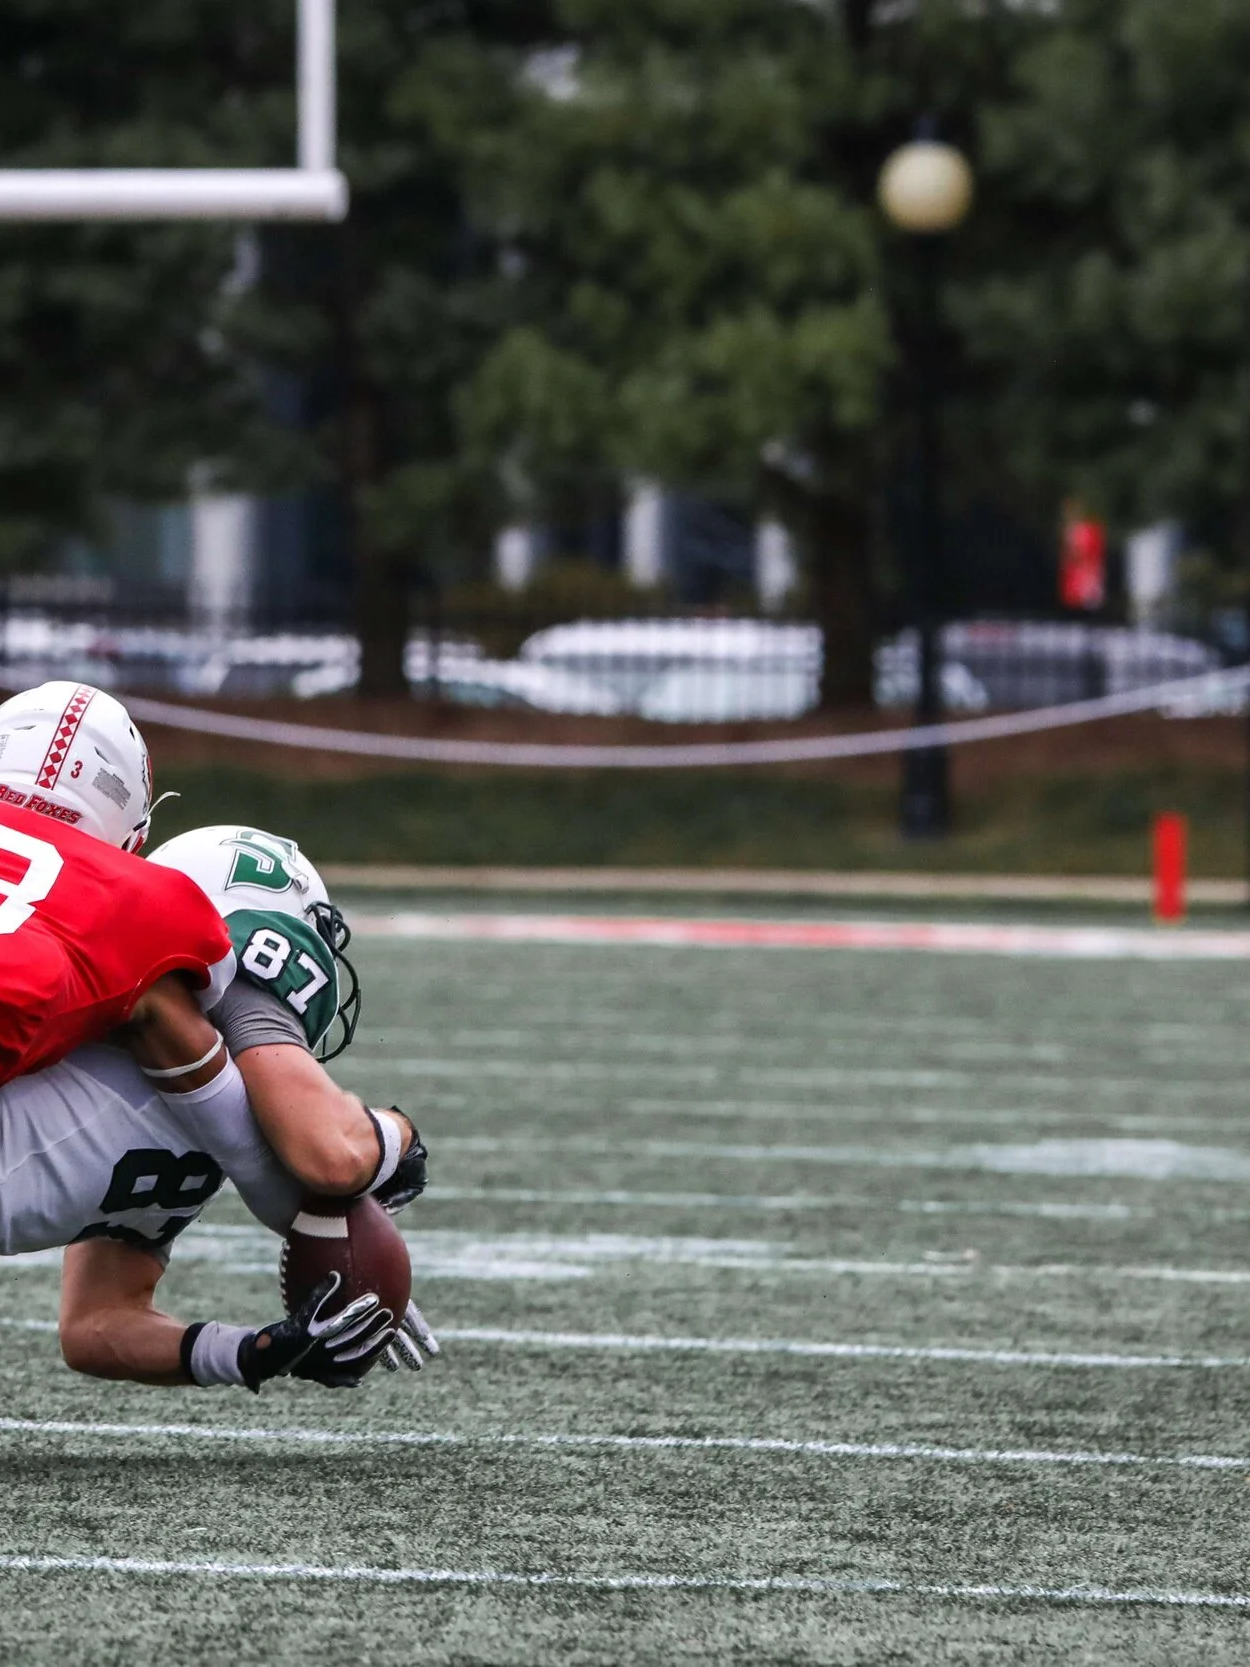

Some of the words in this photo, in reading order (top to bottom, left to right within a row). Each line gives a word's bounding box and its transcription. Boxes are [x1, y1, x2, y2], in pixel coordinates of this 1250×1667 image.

[71, 760, 83, 778] 3
[23, 793, 83, 825] FOXES
[238, 927, 331, 1015] 87
